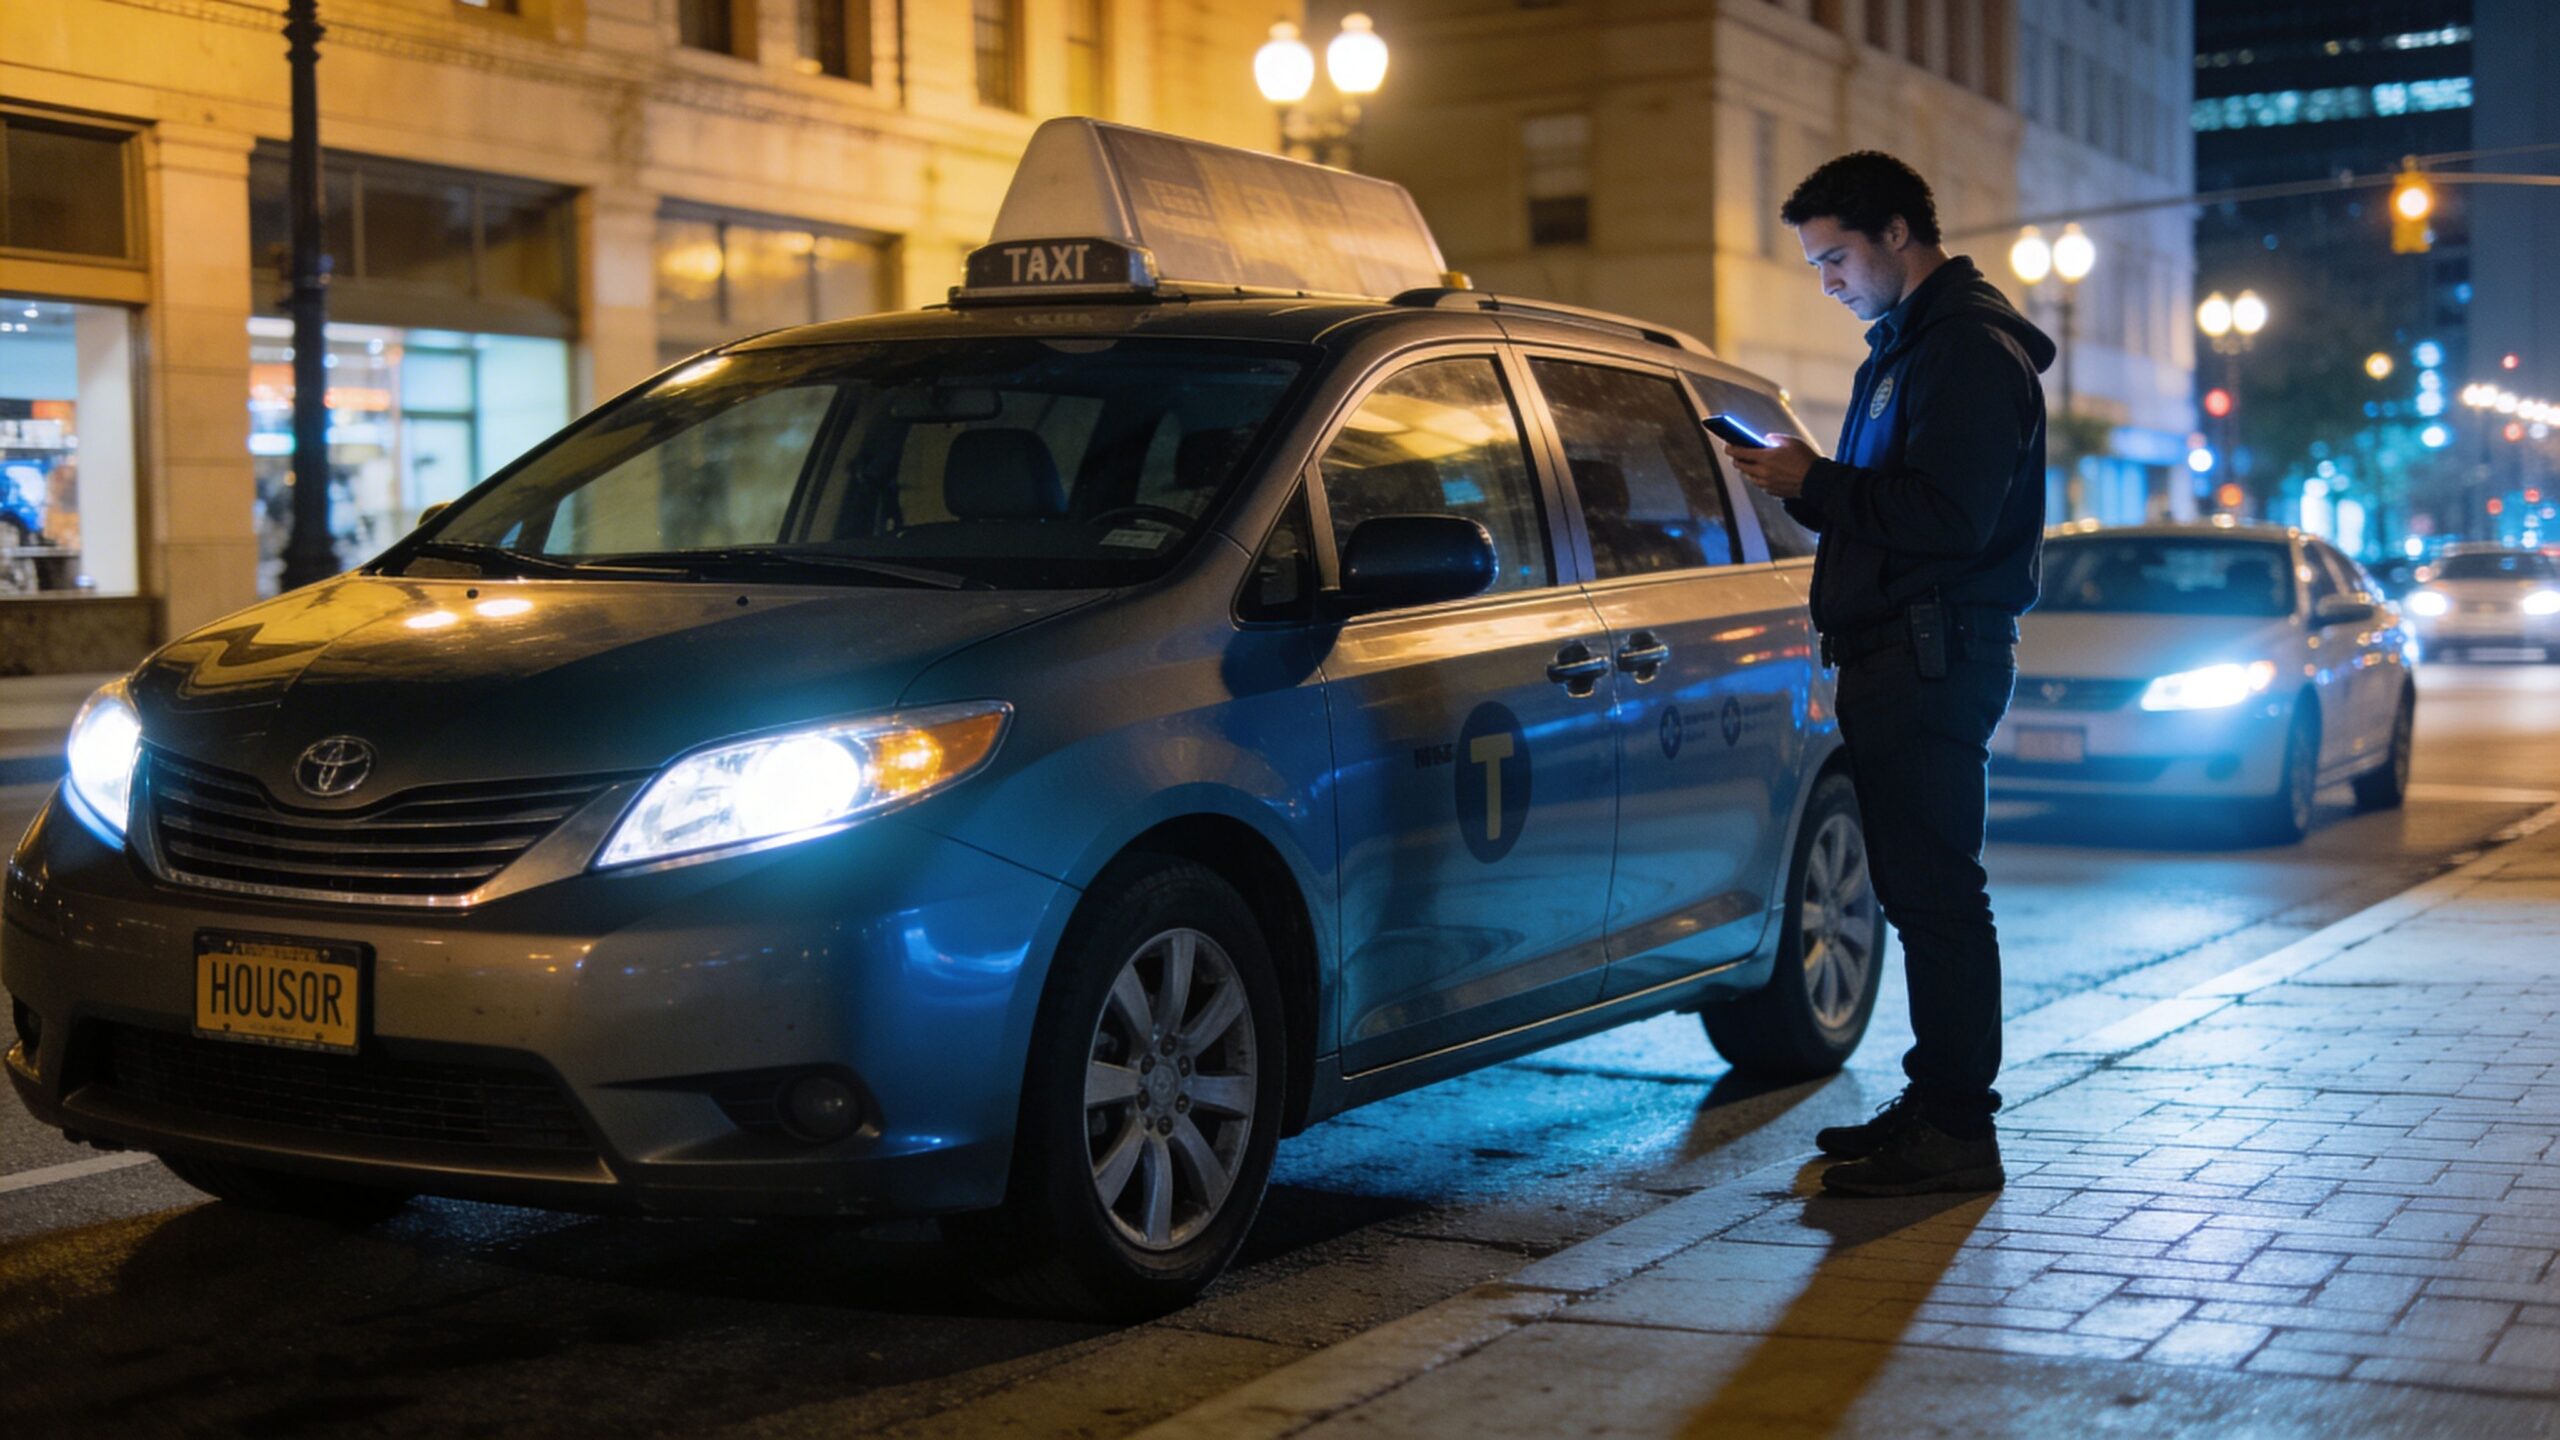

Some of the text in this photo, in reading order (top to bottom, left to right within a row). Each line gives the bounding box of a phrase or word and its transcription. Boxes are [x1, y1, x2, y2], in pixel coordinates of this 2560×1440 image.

[1004, 245, 1090, 282] TAXI
[1470, 732, 1514, 840] T
[211, 961, 342, 1026] HOUSOR
